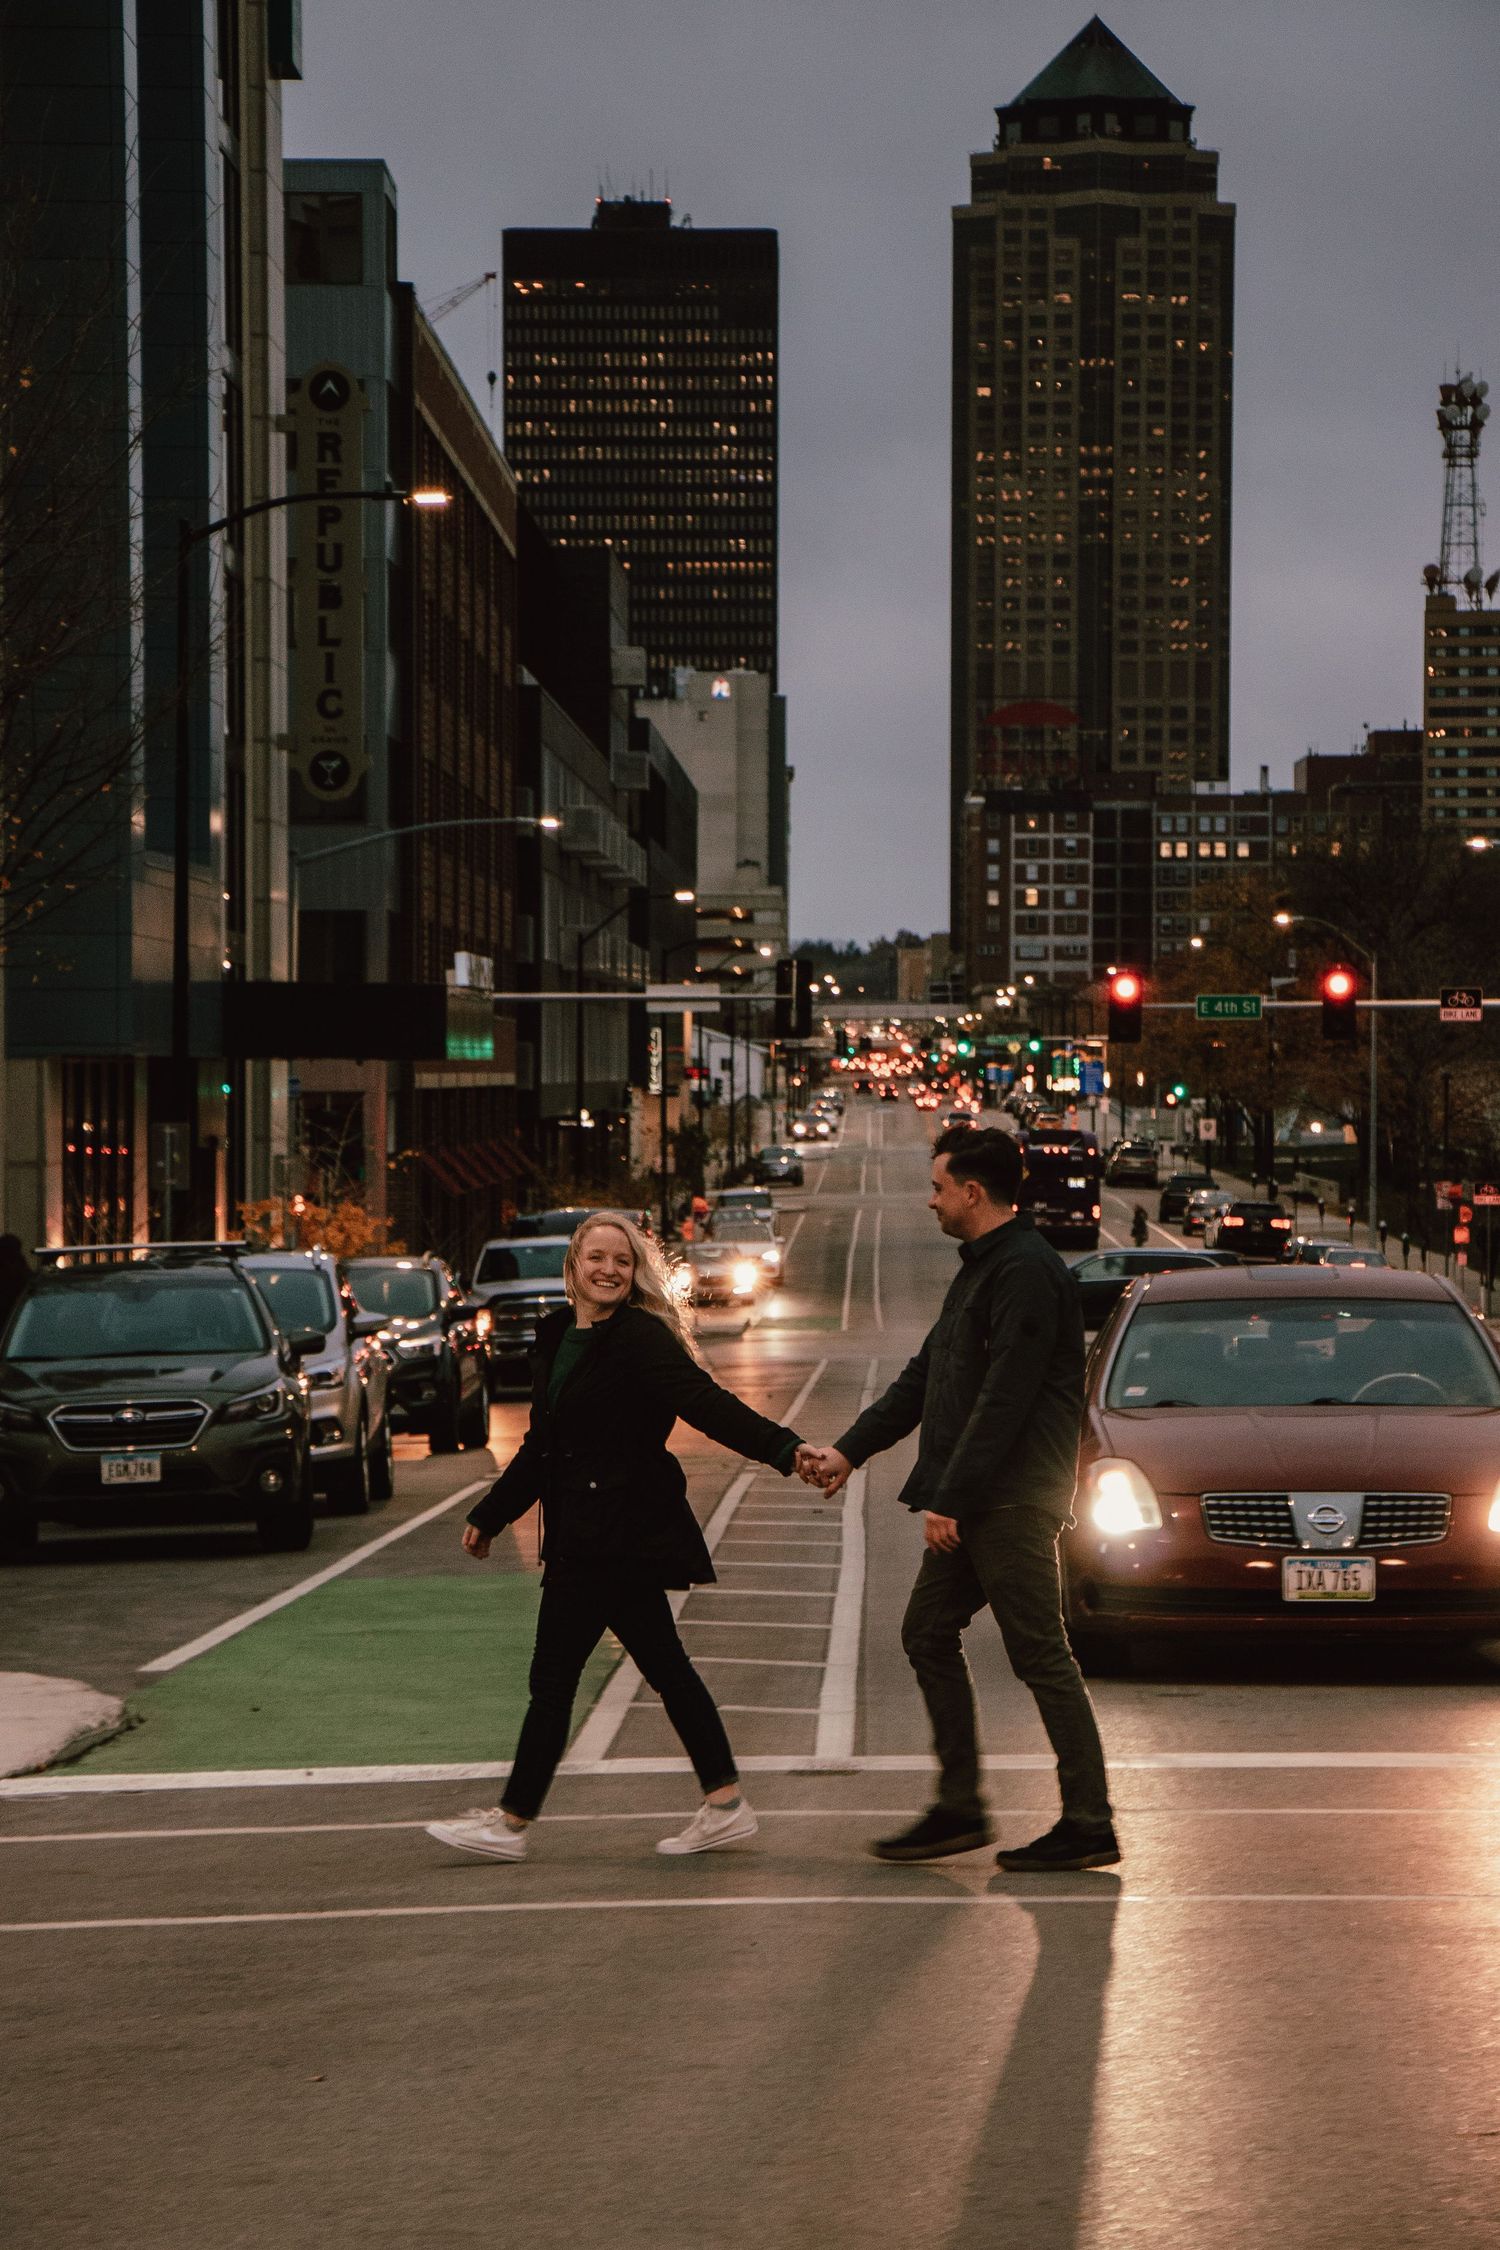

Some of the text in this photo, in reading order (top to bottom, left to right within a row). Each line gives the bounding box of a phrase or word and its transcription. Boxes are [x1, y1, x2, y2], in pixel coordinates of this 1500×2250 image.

[316, 432, 343, 720] REPUBLIC
[1201, 1001, 1257, 1014] E 4th St
[1443, 1010, 1458, 1018] BIKE
[1295, 1569, 1362, 1591] IXA 765
